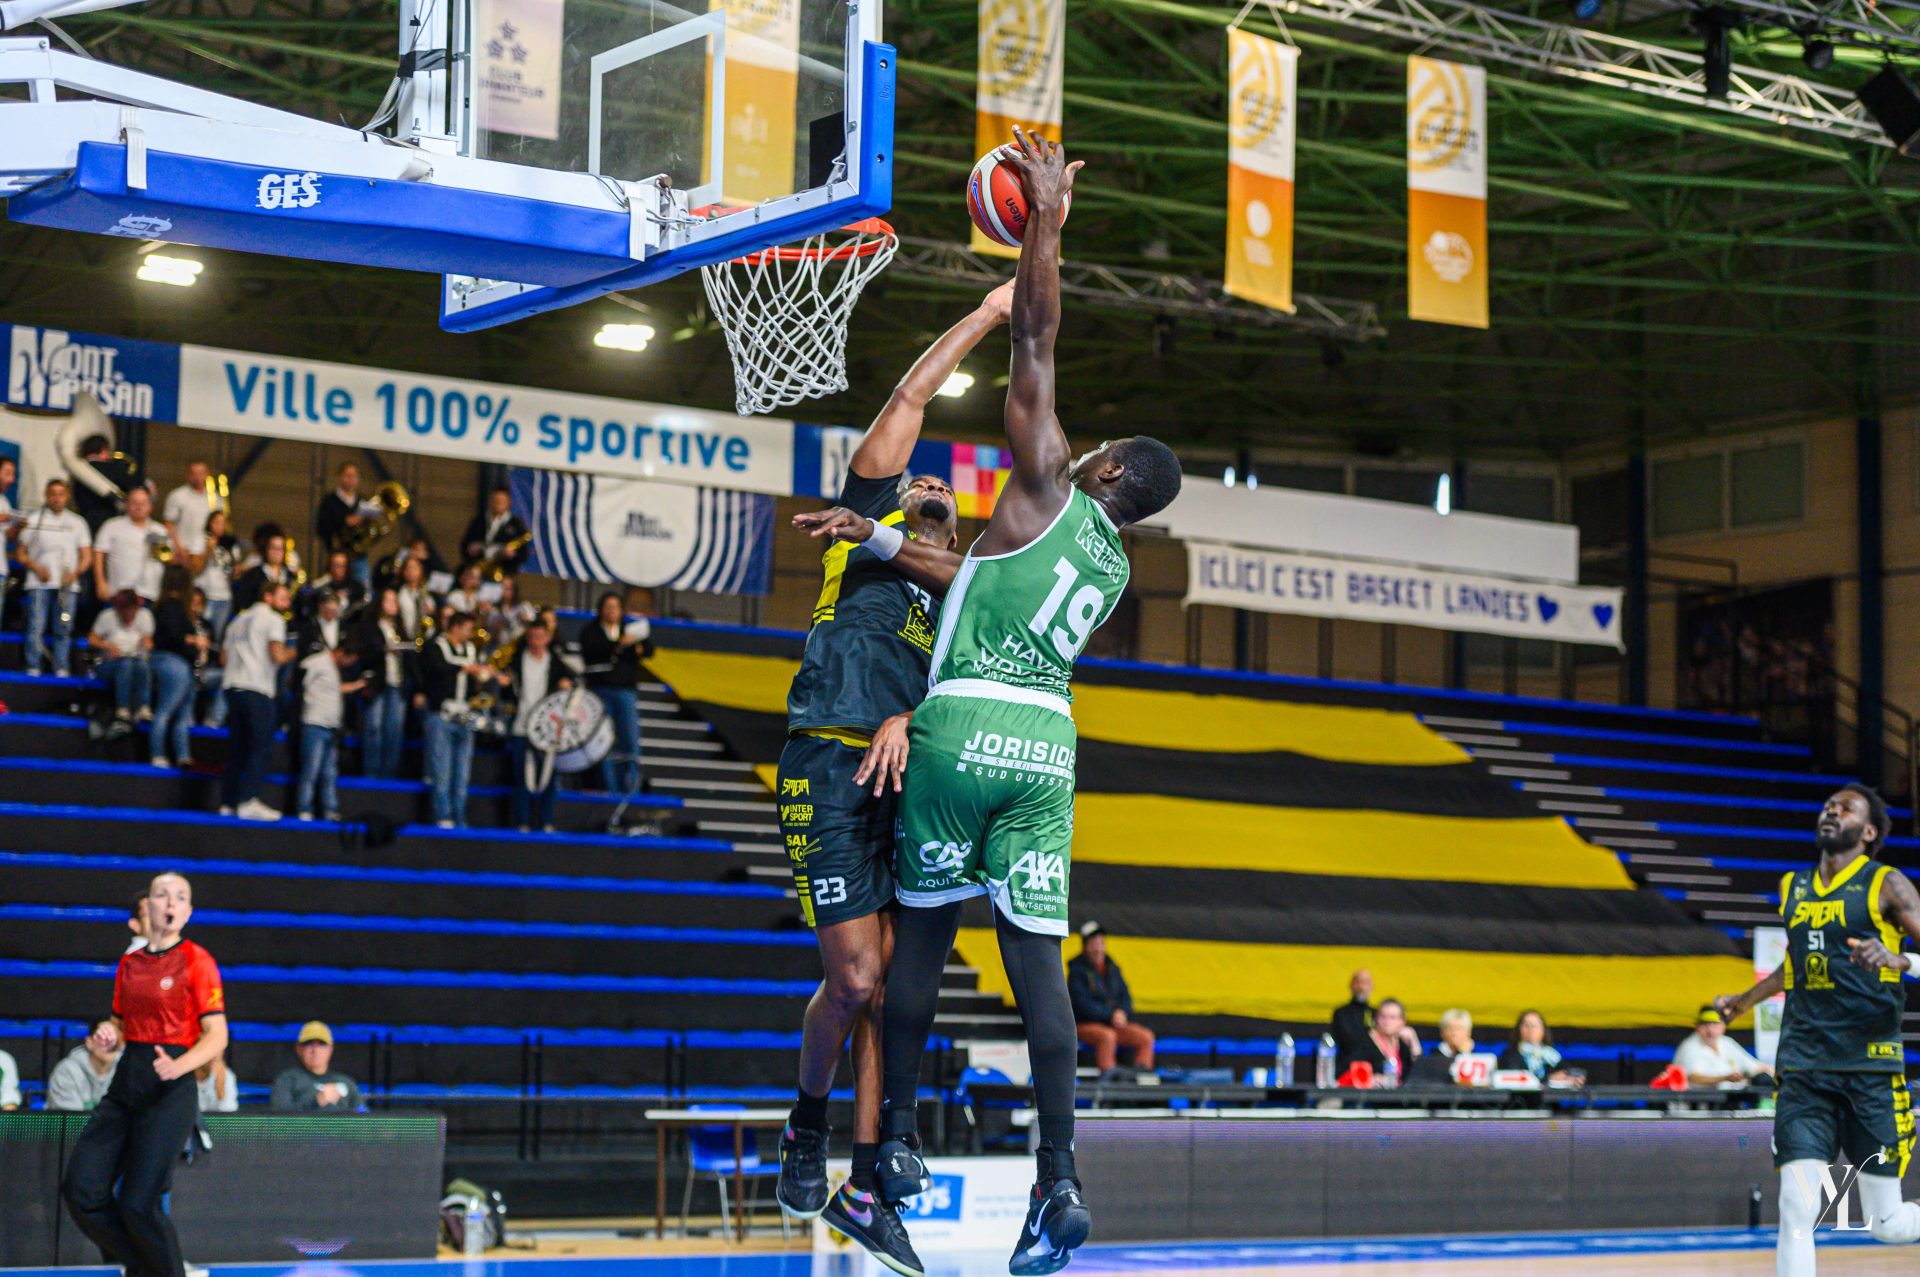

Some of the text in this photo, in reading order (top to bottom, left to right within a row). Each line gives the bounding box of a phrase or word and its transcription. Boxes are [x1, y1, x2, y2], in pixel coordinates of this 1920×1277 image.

[254, 172, 322, 210] GES
[224, 362, 354, 425] Ville
[376, 383, 520, 446] 100%
[538, 412, 752, 473] sportive
[1028, 556, 1105, 662] 19
[1347, 572, 1431, 613] BASKET
[1444, 583, 1530, 623] LANDES
[961, 751, 984, 763] THE
[995, 758, 1032, 770] STEEL
[781, 779, 810, 797] SMBM
[975, 766, 1064, 788] SUD OUEST
[790, 804, 813, 813] INTER
[790, 812, 813, 821] SPORT
[1008, 850, 1066, 895] AXA
[814, 876, 847, 906] 23
[1807, 930, 1825, 950] 51
